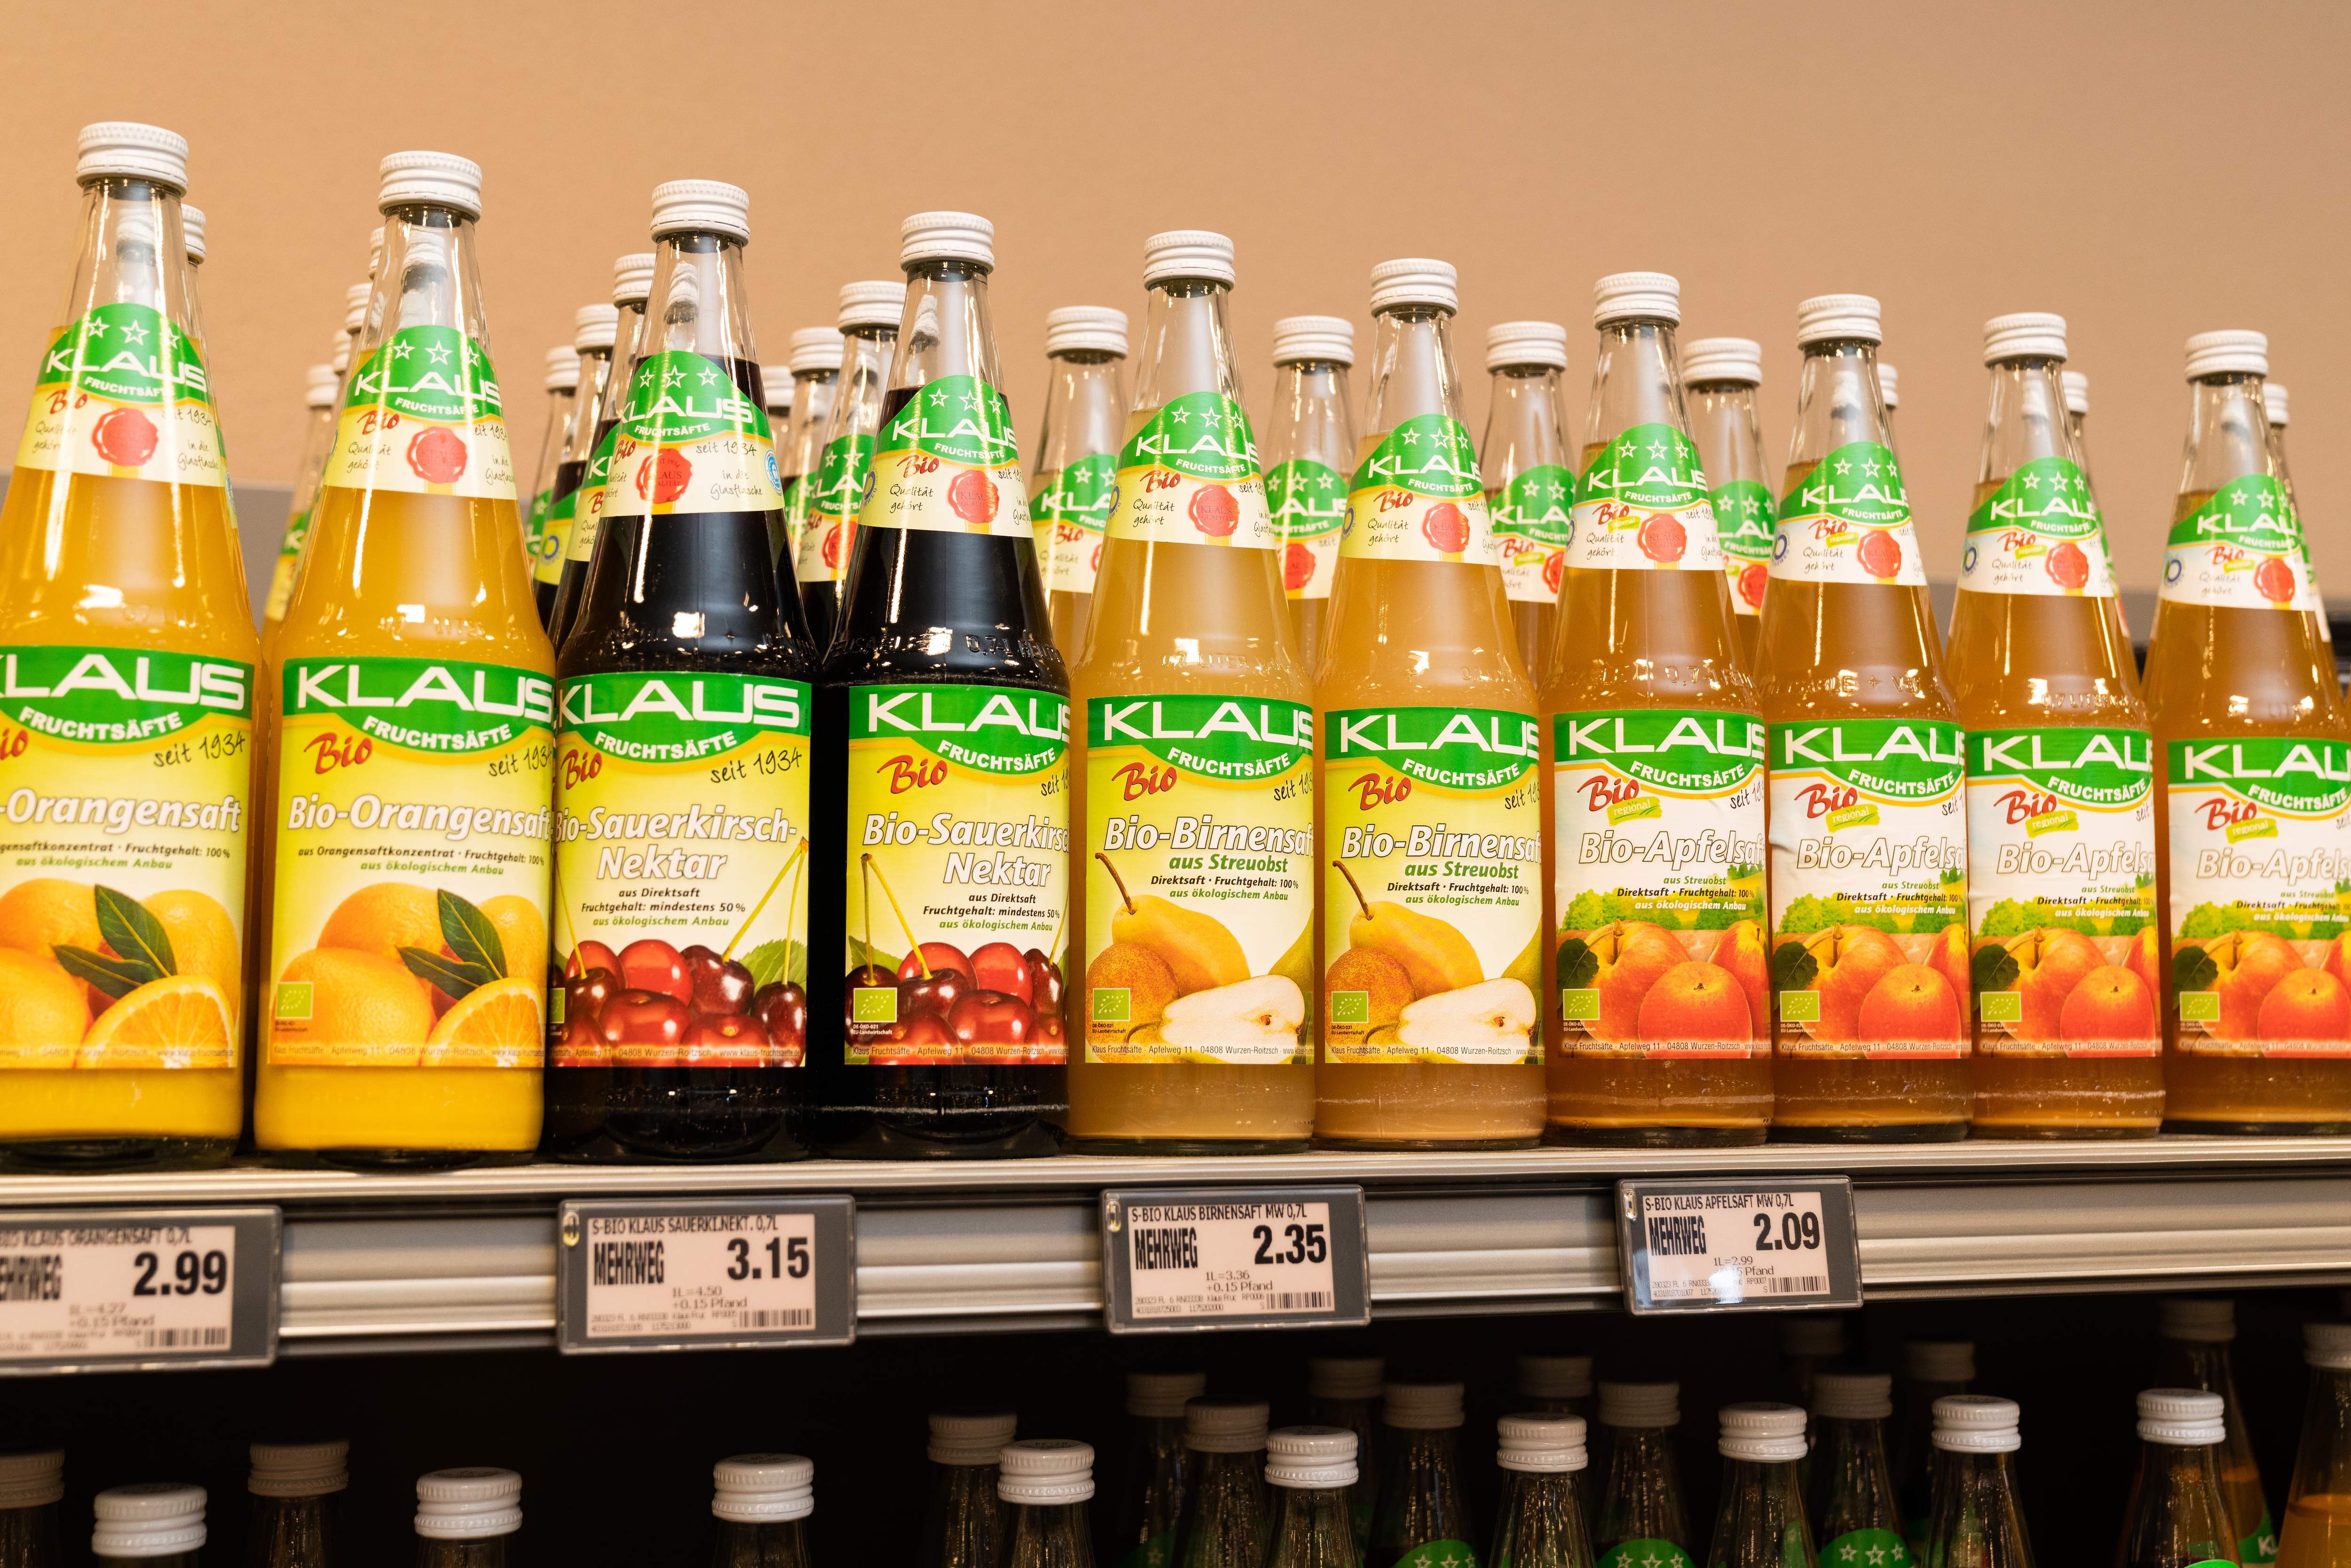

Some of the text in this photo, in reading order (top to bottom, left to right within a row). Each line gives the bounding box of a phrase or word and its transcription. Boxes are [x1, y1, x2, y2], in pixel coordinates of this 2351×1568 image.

[46, 348, 207, 392] KLAUS
[355, 371, 502, 408] KLAUS
[635, 423, 710, 436] FRUCHTSÄFTE
[892, 418, 1017, 450] KLAUS
[696, 440, 757, 456] seit 1934
[1136, 434, 1259, 465] KLAUS
[897, 455, 939, 478] Bio
[1176, 458, 1246, 474] FRUCHTSÄFTE
[1368, 455, 1481, 482] KLAUS
[1588, 466, 1708, 492] KLAUS
[711, 484, 763, 500] Glasflasche
[1408, 478, 1473, 492] FRUCHTSÄFTE
[1625, 491, 1692, 504] FRUCHTSÄFTE
[1368, 518, 1409, 530] Qualität
[1593, 503, 1630, 525] Bio
[1368, 534, 1399, 546] gehört
[0, 654, 245, 710] LAUS
[298, 665, 552, 724] KLAUS
[560, 680, 799, 728] KLAUS
[19, 706, 183, 741] FRUCHTSÄFTE
[869, 693, 1070, 744] KLAUS
[1104, 701, 1313, 751] KLAUS
[363, 716, 512, 749] FRUCHTSÄFTE
[595, 731, 737, 760] FRUCHTSÄFTE
[1341, 714, 1539, 760] KLAUS
[1569, 717, 1765, 760] KLAUS
[154, 731, 245, 767] seit 1934
[304, 732, 373, 774] Bio
[937, 739, 1056, 771] FRUCHTSÄFTE
[1167, 747, 1290, 776] FRUCHTSÄFTE
[1983, 734, 2153, 772] KLAU
[489, 759, 518, 776] seit
[561, 749, 602, 789] Bio
[711, 747, 802, 783] seit 1934
[877, 755, 947, 794] Bio
[1402, 758, 1520, 786] FRUCHTSÄFTE
[1630, 761, 1745, 787] FRUCHTSÄFTE
[2185, 744, 2351, 781] KLAU
[1112, 762, 1177, 801] Bio
[1348, 773, 1412, 811] Bio
[1577, 775, 1639, 812] Bio
[1848, 769, 1954, 795] FRUCHTSÄFTE
[2047, 776, 2146, 801] FRUCHTSÄFTE
[1613, 799, 1651, 816] regional
[1794, 783, 1858, 818] Bio
[1993, 791, 2057, 824] Bio
[2248, 784, 2347, 810] FRUCHTSÄFTE
[0, 787, 241, 835] -Orangensaft
[288, 793, 550, 840] Bio-Orangensaft
[555, 804, 797, 842] Bio-Sauerkirsch-
[1832, 808, 1869, 823] regional
[2032, 813, 2068, 828] regional
[2194, 798, 2257, 830] Bio
[862, 812, 1070, 853] Bio-Sauerkirsc
[299, 848, 313, 856] aus
[317, 846, 454, 858] Orangensaftkonzentrat
[465, 850, 526, 863] Fruchtgehalt:
[597, 844, 728, 880] Nektar
[1169, 854, 1288, 873] aus Streuobst
[943, 852, 1051, 887] Nektar
[1151, 876, 1298, 889] Direktsaft Fruchtgehalt: 100%
[1684, 876, 1726, 885] Streuobst
[641, 888, 700, 898] Direktsaft
[991, 893, 1036, 904] Direktsaft
[1192, 888, 1260, 900] ökologischem
[1263, 891, 1288, 901] Anbau
[1388, 882, 1529, 895] Direktsaft Fruchtgehalt: 100%
[1617, 888, 1669, 897] Direktsaft
[1679, 888, 1736, 899] Fruchtgehalt:
[582, 902, 646, 913] Fruchtgehalt:
[650, 903, 715, 912] mindestens
[923, 906, 995, 918] Fruchtgehalt:
[999, 908, 1045, 918] mindestens
[1657, 900, 1720, 911] ökologischem
[645, 1048, 711, 1057] Wurzen-Roitzsch
[918, 1047, 952, 1056] Apfelweg
[996, 1047, 1044, 1055] Wurzen-Roitzsch
[1149, 1046, 1181, 1055] Apfelweg
[1132, 1208, 1161, 1222] S-BIO
[1165, 1206, 1196, 1221] KLAUS
[1199, 1205, 1261, 1220] BIRNENSAFT
[1266, 1204, 1284, 1219] MW
[1646, 1198, 1672, 1210] S-BIO
[1675, 1196, 1703, 1209] KLAUS
[1705, 1194, 1753, 1209] APFELSAFT
[1757, 1194, 1773, 1207] MW
[593, 1219, 626, 1235] S-BIO
[629, 1217, 665, 1234] KLAUS
[1648, 1212, 1820, 1256] MEHRWEG 2.09
[1134, 1224, 1326, 1269] MEHRWEG 2.35
[133, 1250, 228, 1296] 2.99
[594, 1237, 809, 1285] MEHRWEG 3.15
[1713, 1256, 1752, 1266] 1L=2.99
[1745, 1266, 1774, 1275] Pfand
[1206, 1270, 1249, 1281] 1L=3.36
[1207, 1281, 1272, 1292] +0.15 Pfand
[711, 1297, 747, 1308] Pfand
